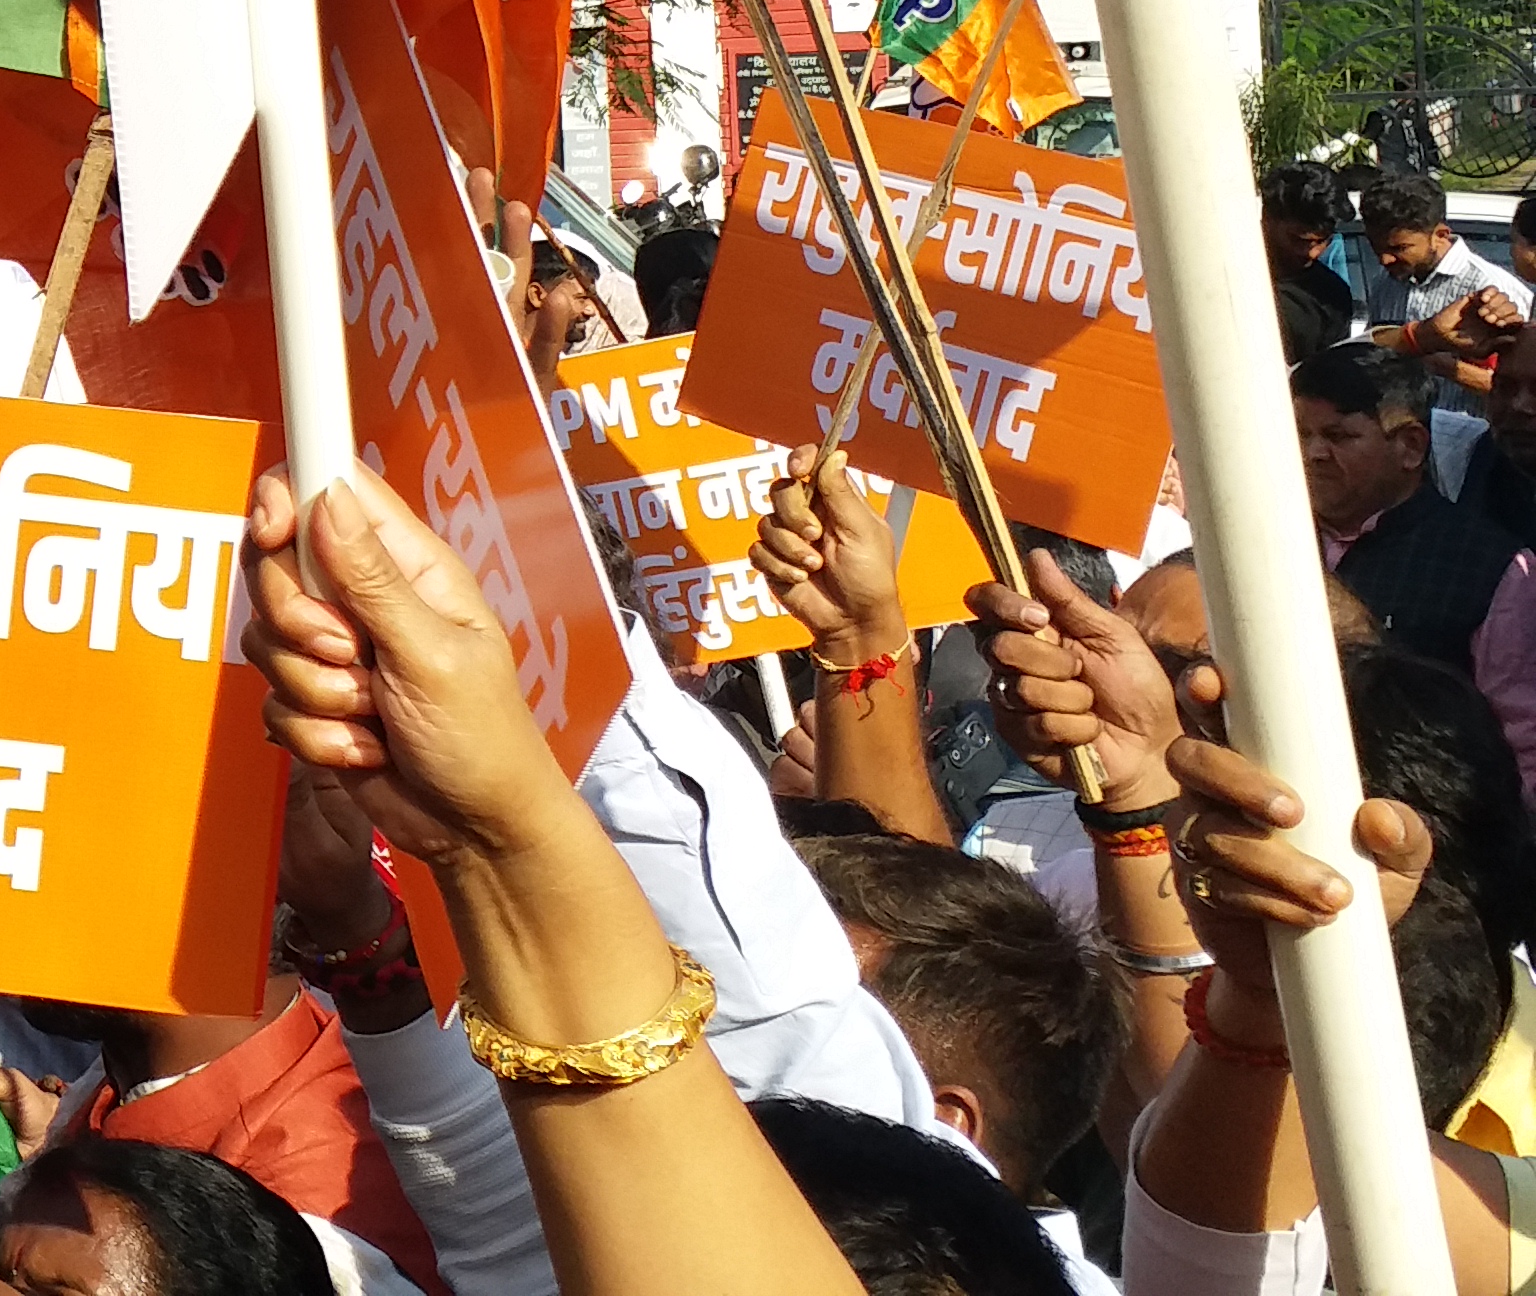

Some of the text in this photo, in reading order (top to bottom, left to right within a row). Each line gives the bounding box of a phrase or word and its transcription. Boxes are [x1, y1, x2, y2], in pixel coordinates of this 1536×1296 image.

[756, 141, 1153, 333] राहुल-सोनिय
[550, 376, 639, 450] PM
[632, 545, 790, 651] हिंदुस्त
